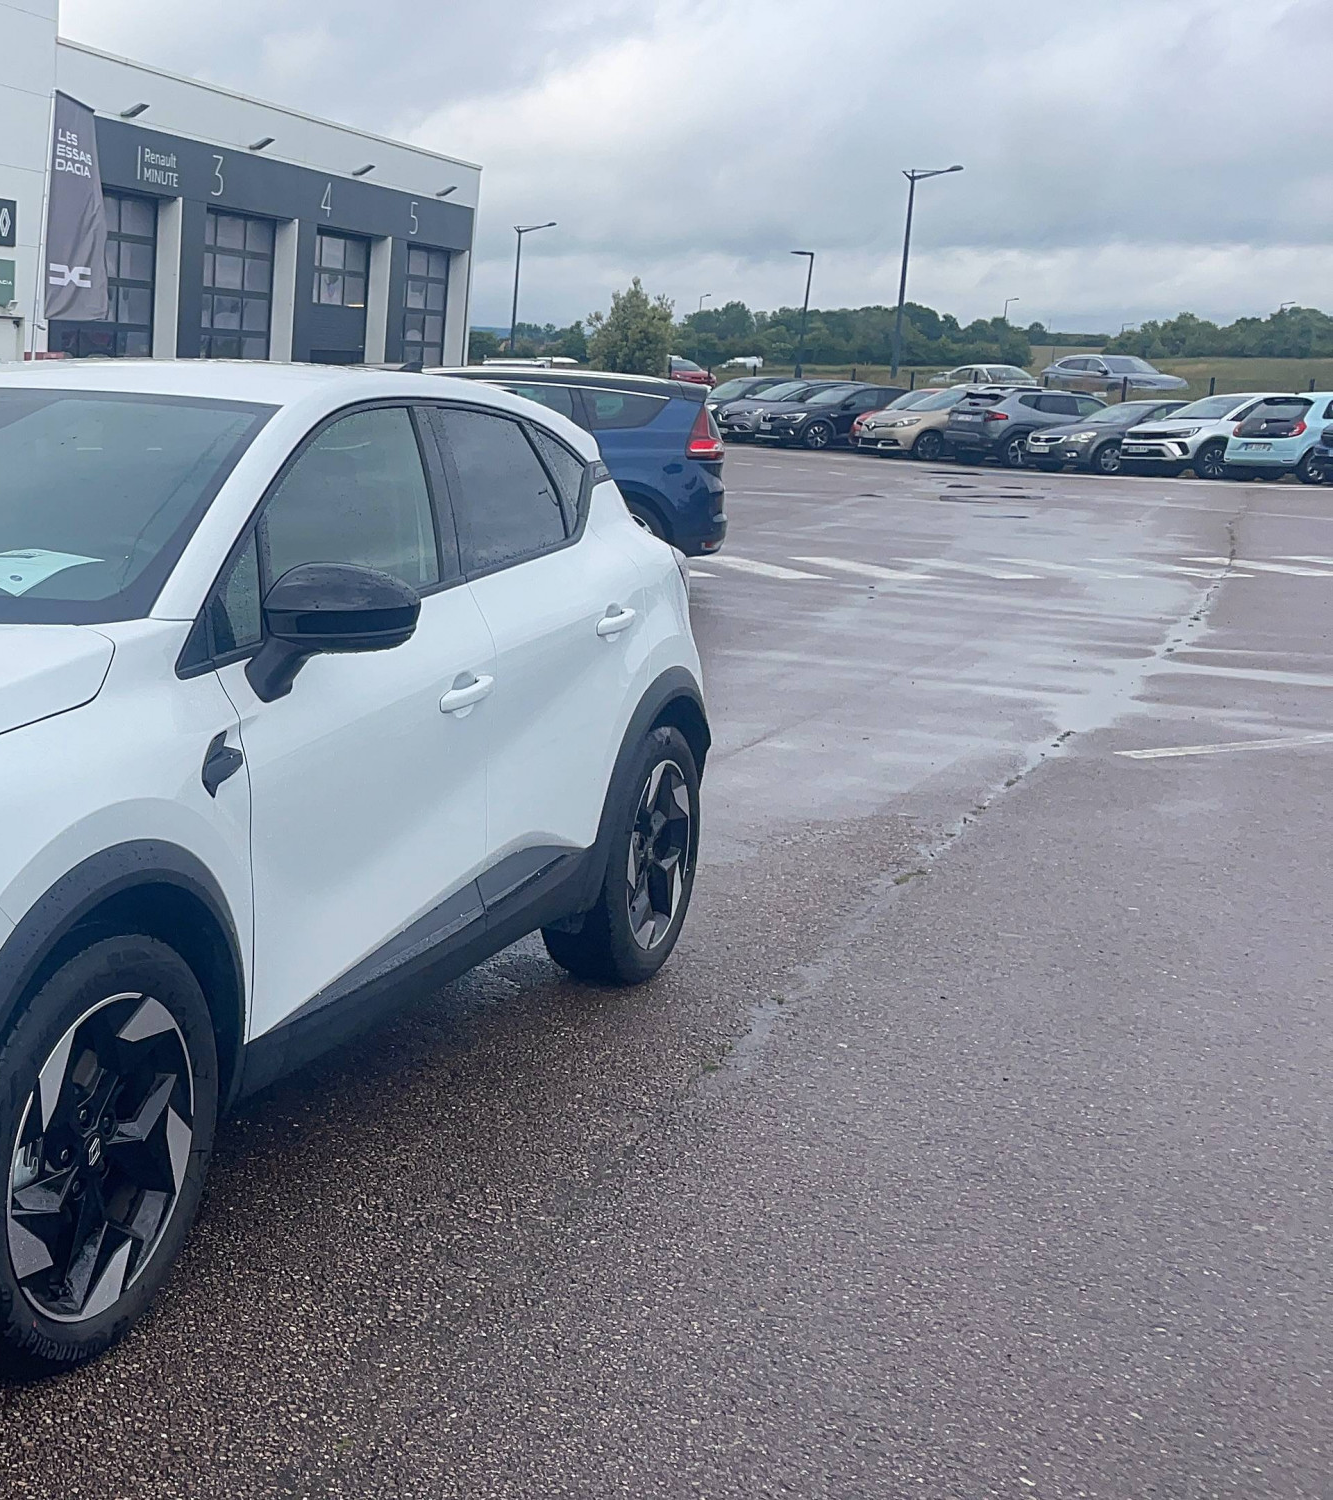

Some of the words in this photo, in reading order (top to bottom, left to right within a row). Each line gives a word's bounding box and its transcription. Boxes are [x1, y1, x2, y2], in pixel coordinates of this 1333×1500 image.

[58, 127, 78, 146] LES
[55, 158, 92, 179] DACIA
[144, 147, 177, 169] Renault
[143, 167, 179, 188] MINUTE
[210, 154, 224, 196] 3
[320, 181, 332, 218] 4
[409, 201, 419, 235] 5
